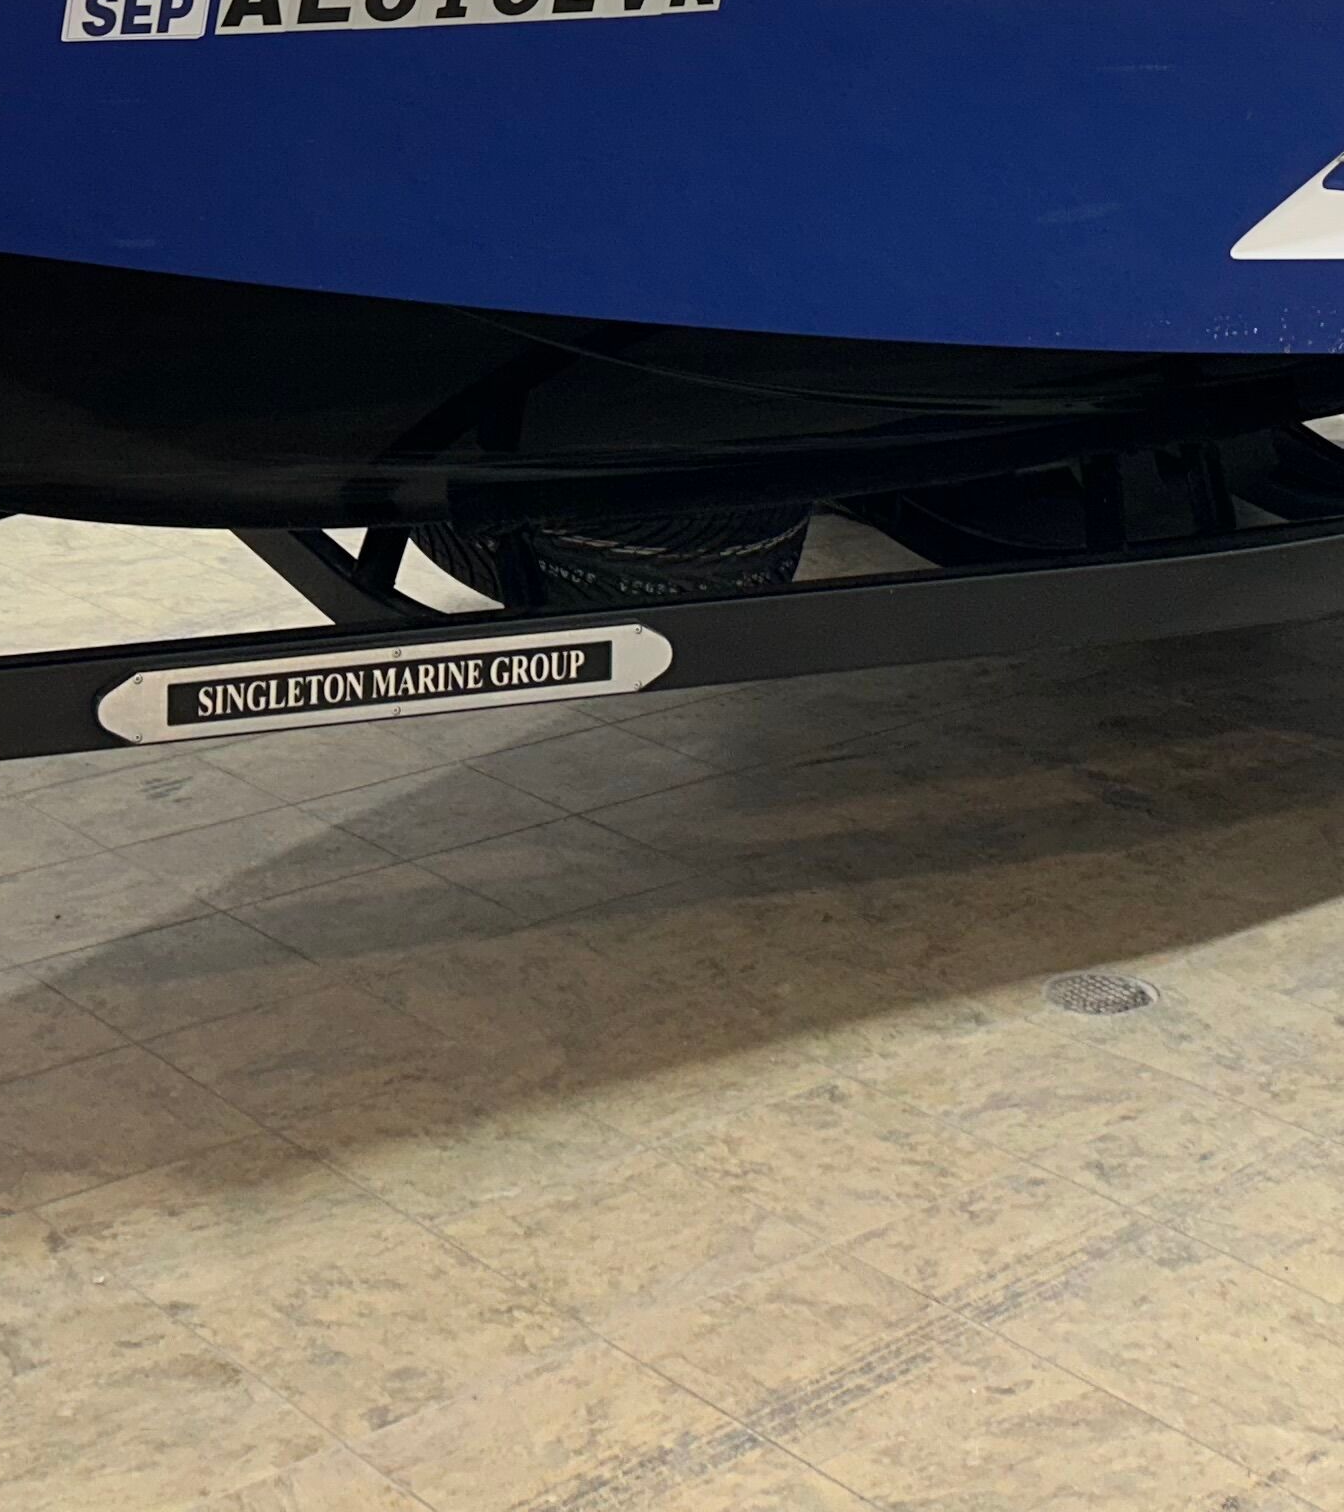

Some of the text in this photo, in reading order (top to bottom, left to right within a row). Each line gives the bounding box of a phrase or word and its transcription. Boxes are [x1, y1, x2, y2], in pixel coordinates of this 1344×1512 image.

[196, 649, 586, 717] SINGLETON MARINE GROUP
